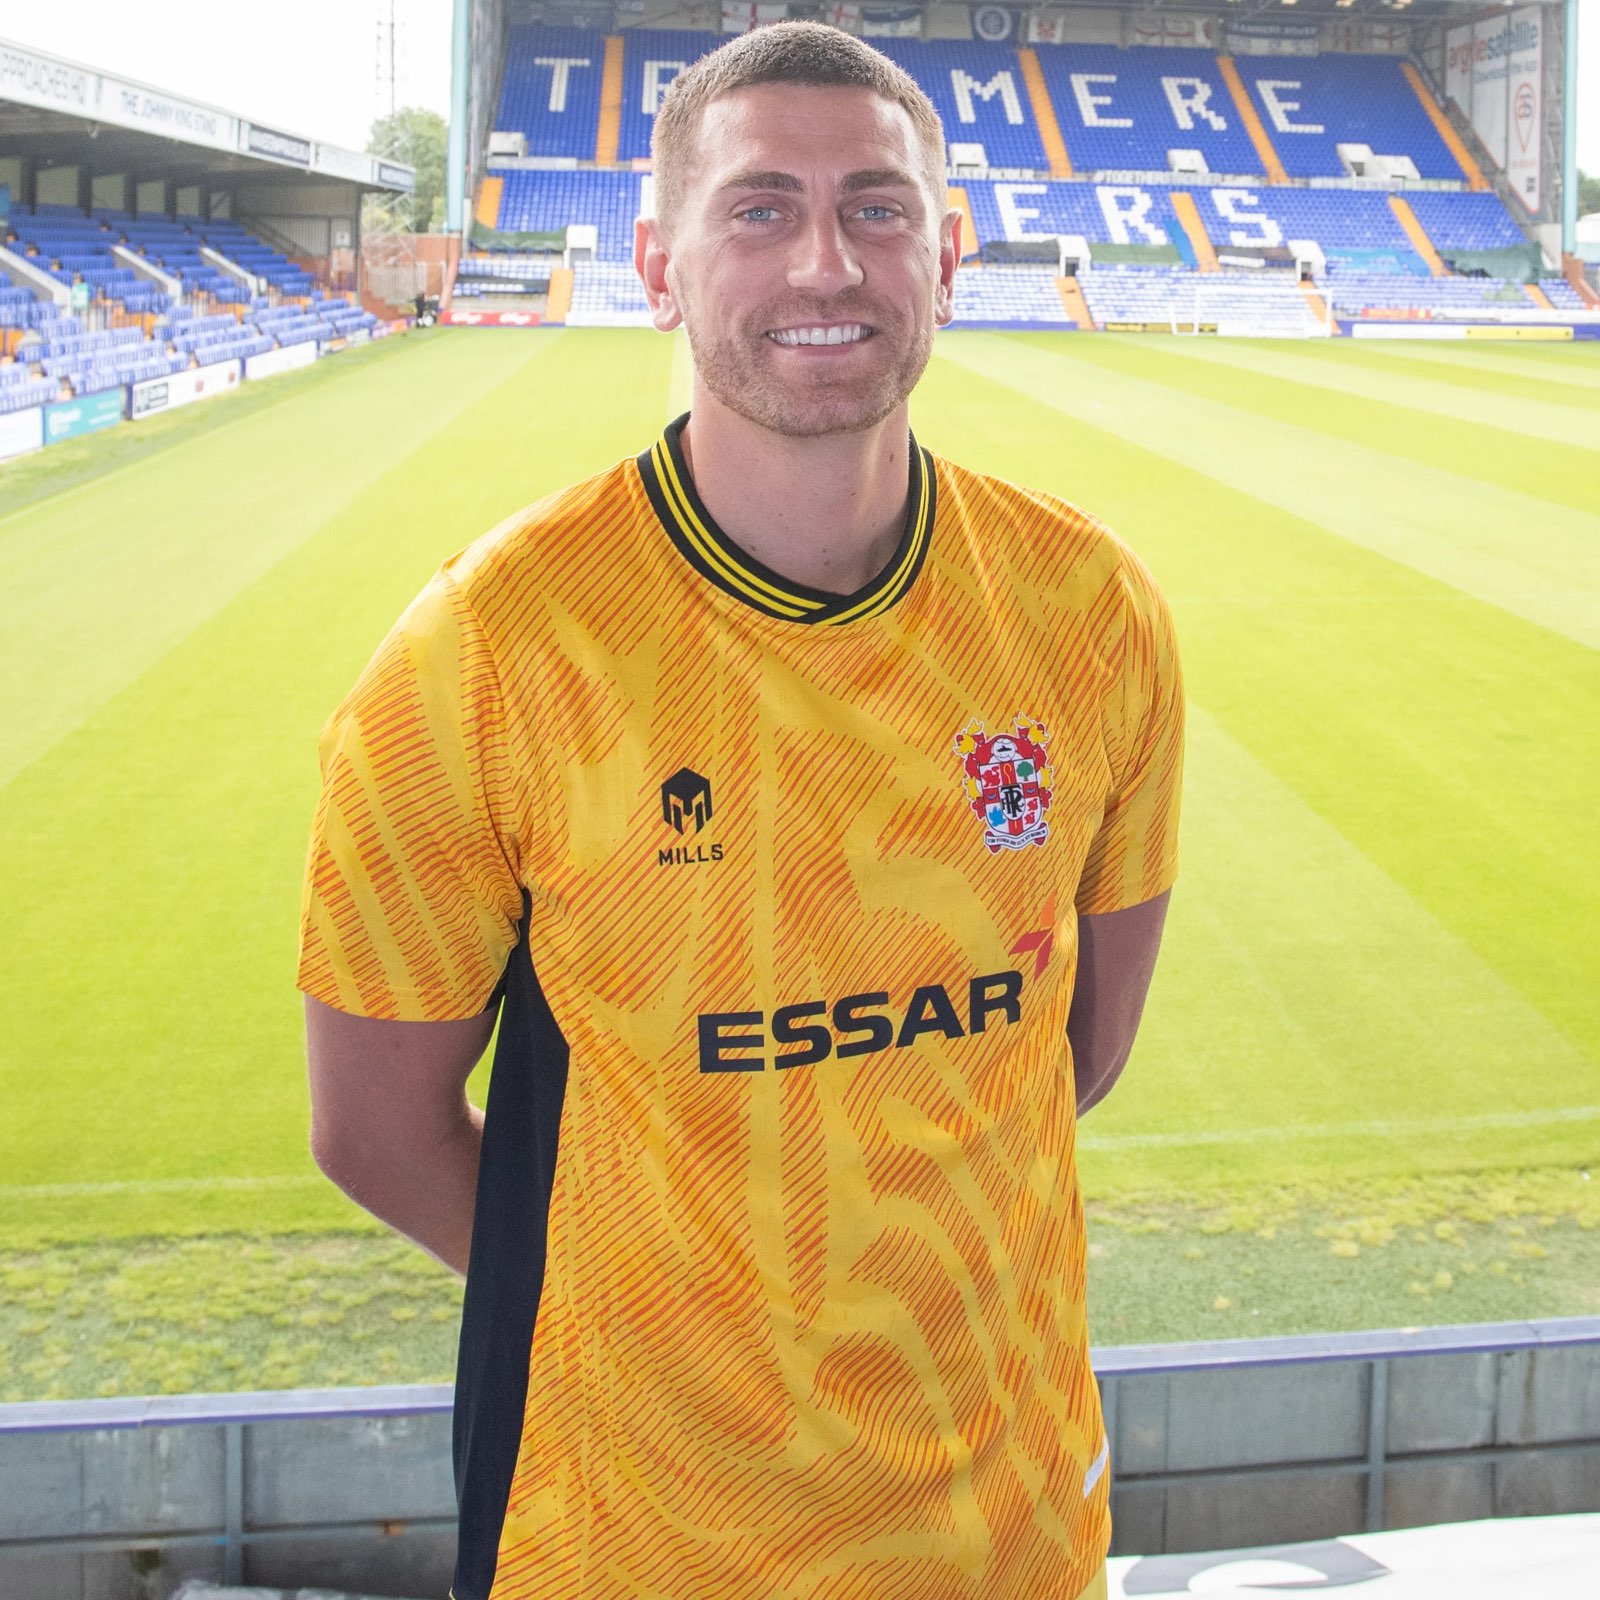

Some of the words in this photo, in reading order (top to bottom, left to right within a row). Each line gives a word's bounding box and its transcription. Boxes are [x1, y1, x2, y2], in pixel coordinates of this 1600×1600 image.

[121, 91, 139, 117] THE
[658, 843, 723, 867] MILLS
[697, 970, 1023, 1074] ESSAR
